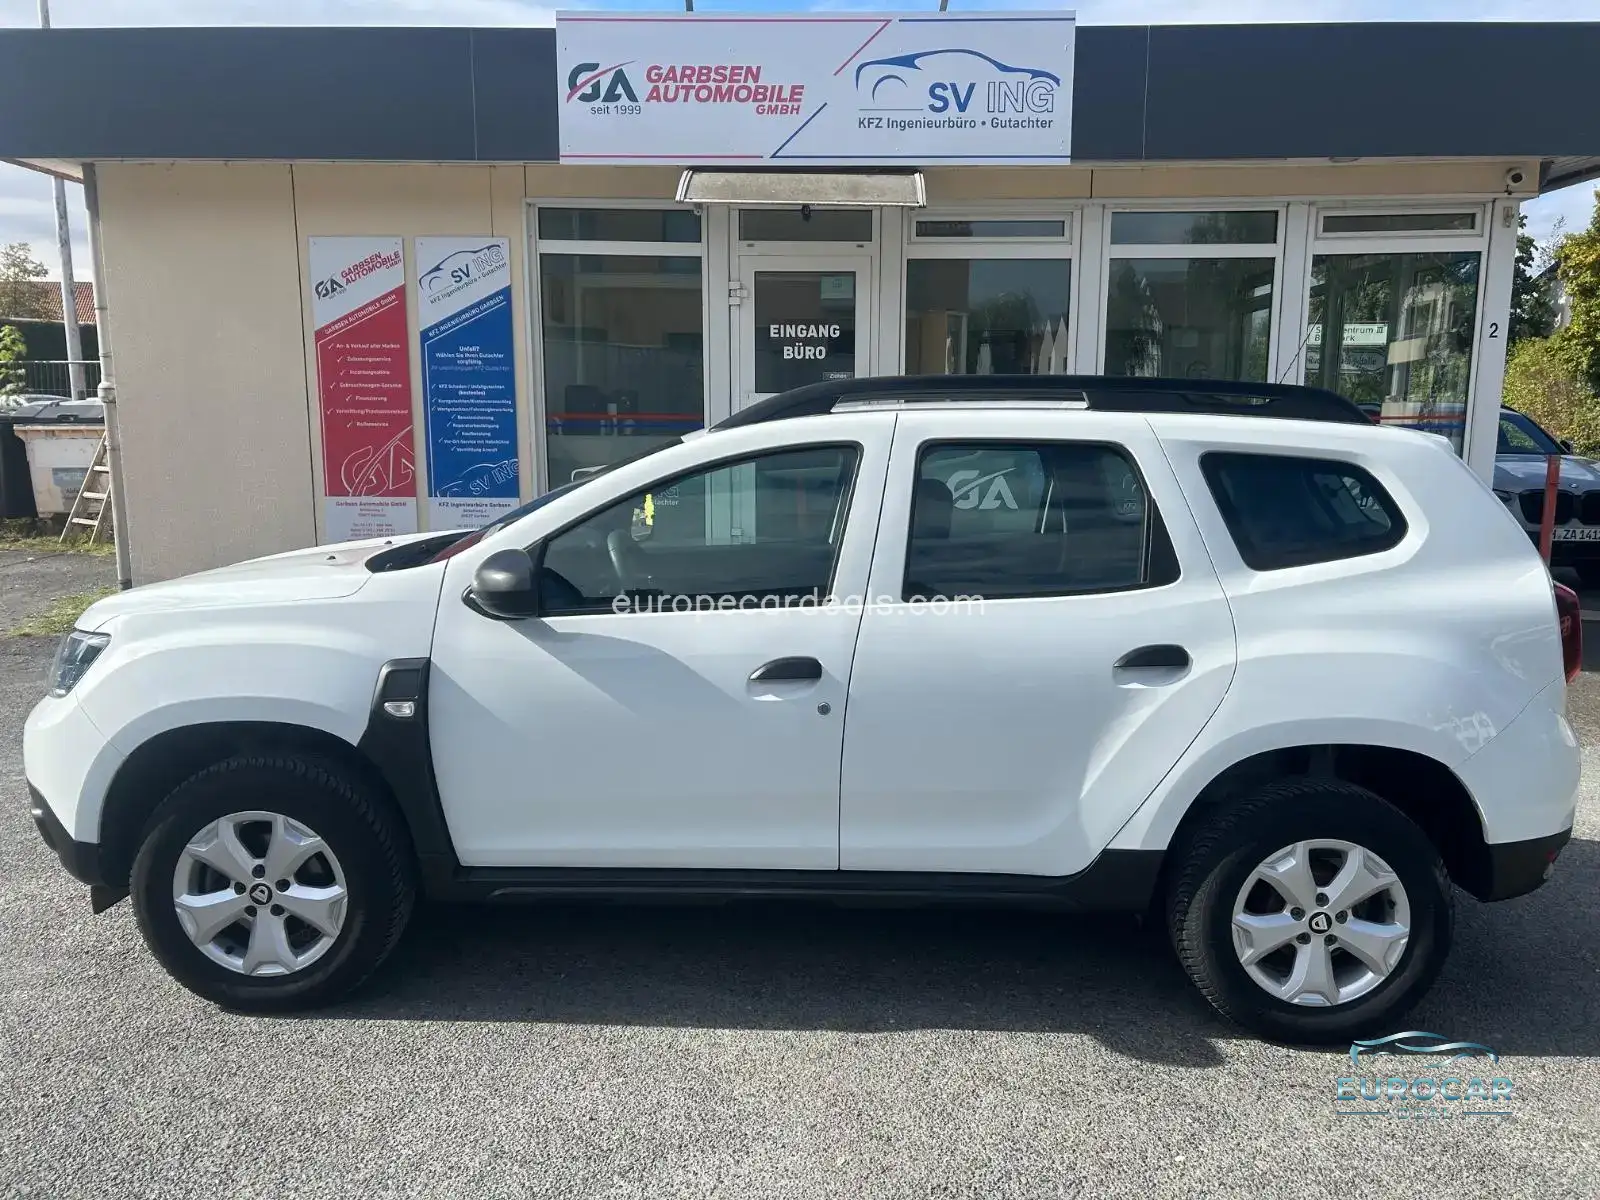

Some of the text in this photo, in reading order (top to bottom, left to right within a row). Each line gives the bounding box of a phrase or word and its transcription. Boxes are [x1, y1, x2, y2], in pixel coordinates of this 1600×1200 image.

[646, 65, 761, 83] GARBSEN
[645, 85, 804, 102] AUTOMOBILE
[928, 80, 1054, 113] SV ING
[591, 105, 641, 115] seit 1999
[756, 104, 800, 115] GMBH
[858, 117, 1053, 131] KFZ Ingenieurbüro Gutachter
[341, 251, 382, 278] GARBSEN
[346, 250, 400, 285] AUTOMOBILE
[451, 247, 504, 283] SV ING
[441, 277, 478, 299] Ingenieurbüro
[482, 261, 507, 278] Gutachter
[349, 301, 380, 322] AUTOMOBILE
[428, 328, 440, 338] KFZ
[769, 324, 840, 338] EINGANG
[1489, 322, 1498, 338] 2
[783, 342, 826, 359] BÜRO
[470, 475, 490, 495] SV
[1563, 529, 1577, 540] ZA
[1579, 529, 1600, 540] 141
